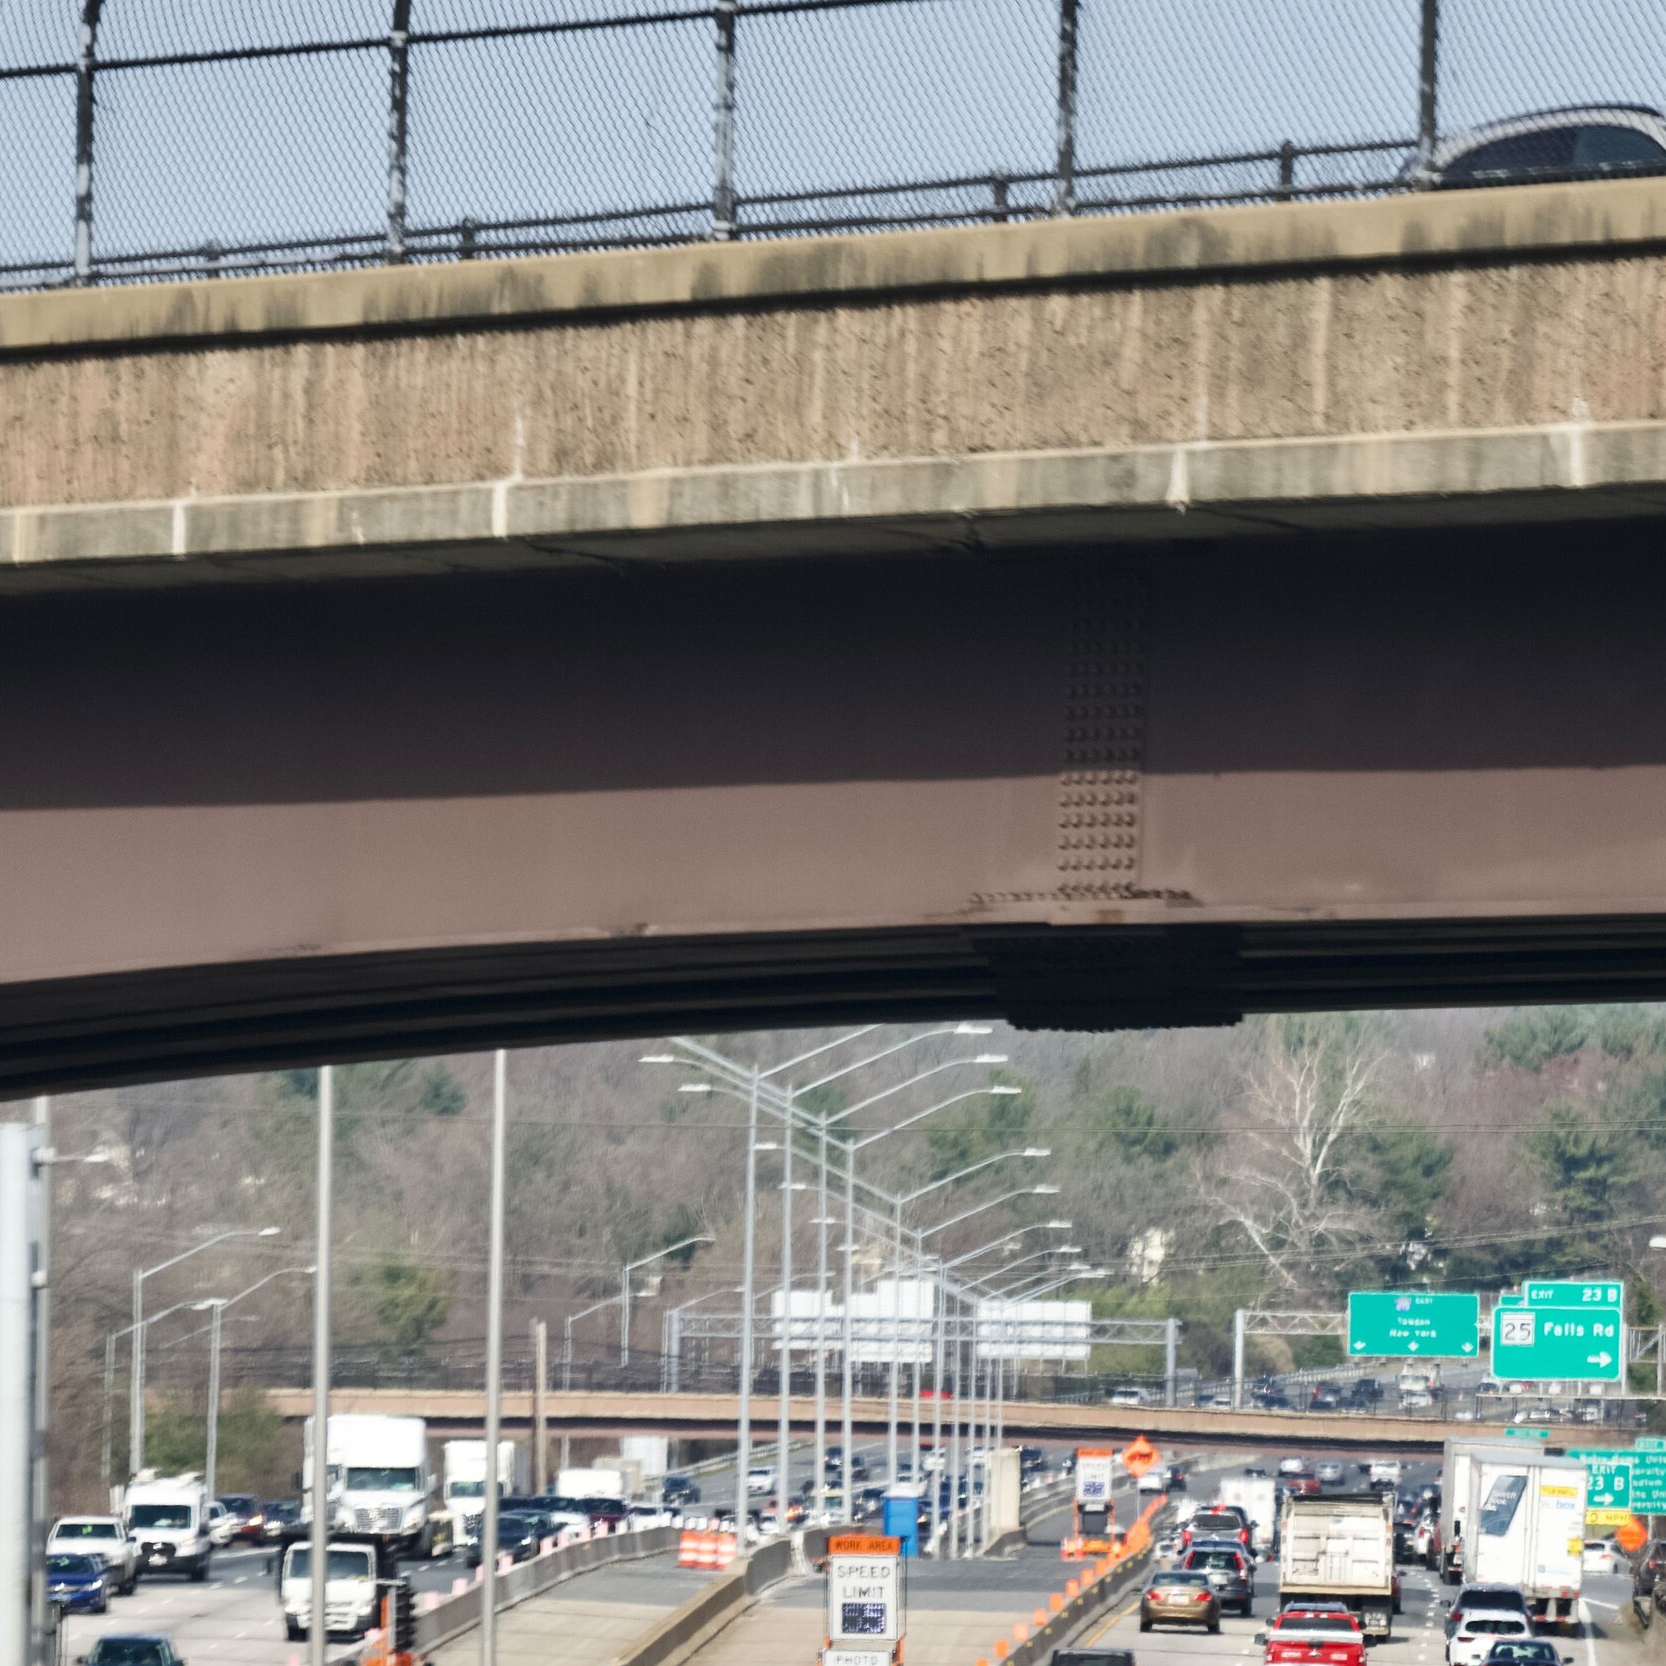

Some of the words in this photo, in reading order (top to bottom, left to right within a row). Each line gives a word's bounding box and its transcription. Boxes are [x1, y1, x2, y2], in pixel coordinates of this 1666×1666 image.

[1531, 1289, 1554, 1300] EXIT
[1582, 1287, 1602, 1302] 23
[1505, 1323, 1531, 1341] 25
[1544, 1322, 1584, 1337] Falls
[1593, 1323, 1614, 1337] Rd
[1606, 1513, 1628, 1521] MPH
[835, 1541, 860, 1550] WORK
[869, 1542, 893, 1550] AREA
[837, 1565, 890, 1578] SPEED
[843, 1586, 885, 1598] LIMIT
[836, 1655, 878, 1666] PHOTO
